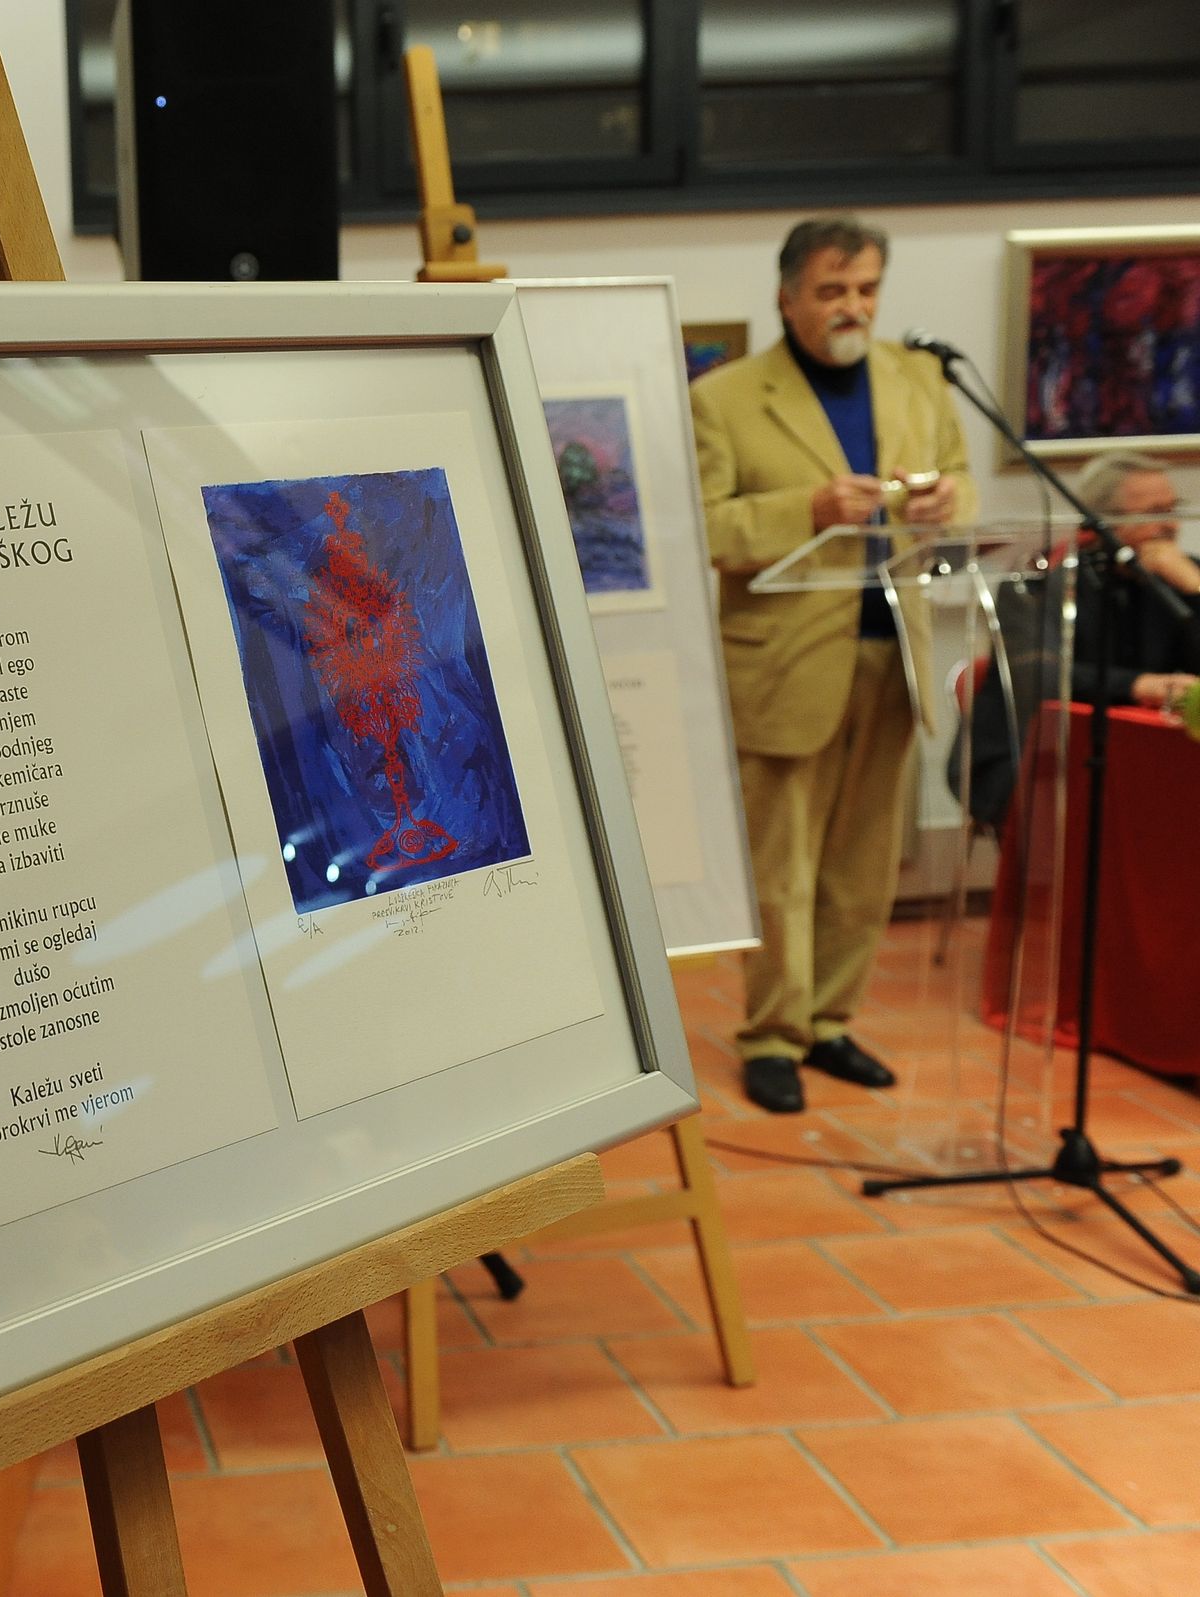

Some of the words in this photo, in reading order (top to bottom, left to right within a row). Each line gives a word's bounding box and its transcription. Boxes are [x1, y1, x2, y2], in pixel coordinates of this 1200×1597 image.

[7, 658, 35, 675] ego
[14, 818, 57, 842] muke
[9, 843, 65, 872] izbaviti
[51, 896, 97, 920] rupcu
[0, 939, 20, 961] mi
[24, 939, 39, 955] se
[43, 920, 98, 952] ogledaj
[13, 963, 51, 987] dušo
[62, 975, 115, 1002] oćutim
[40, 1007, 101, 1040] zanosne
[10, 1077, 64, 1107] Kaležu
[69, 1062, 104, 1089] sveti
[54, 1101, 78, 1124] me
[81, 1084, 134, 1115] vjerom
